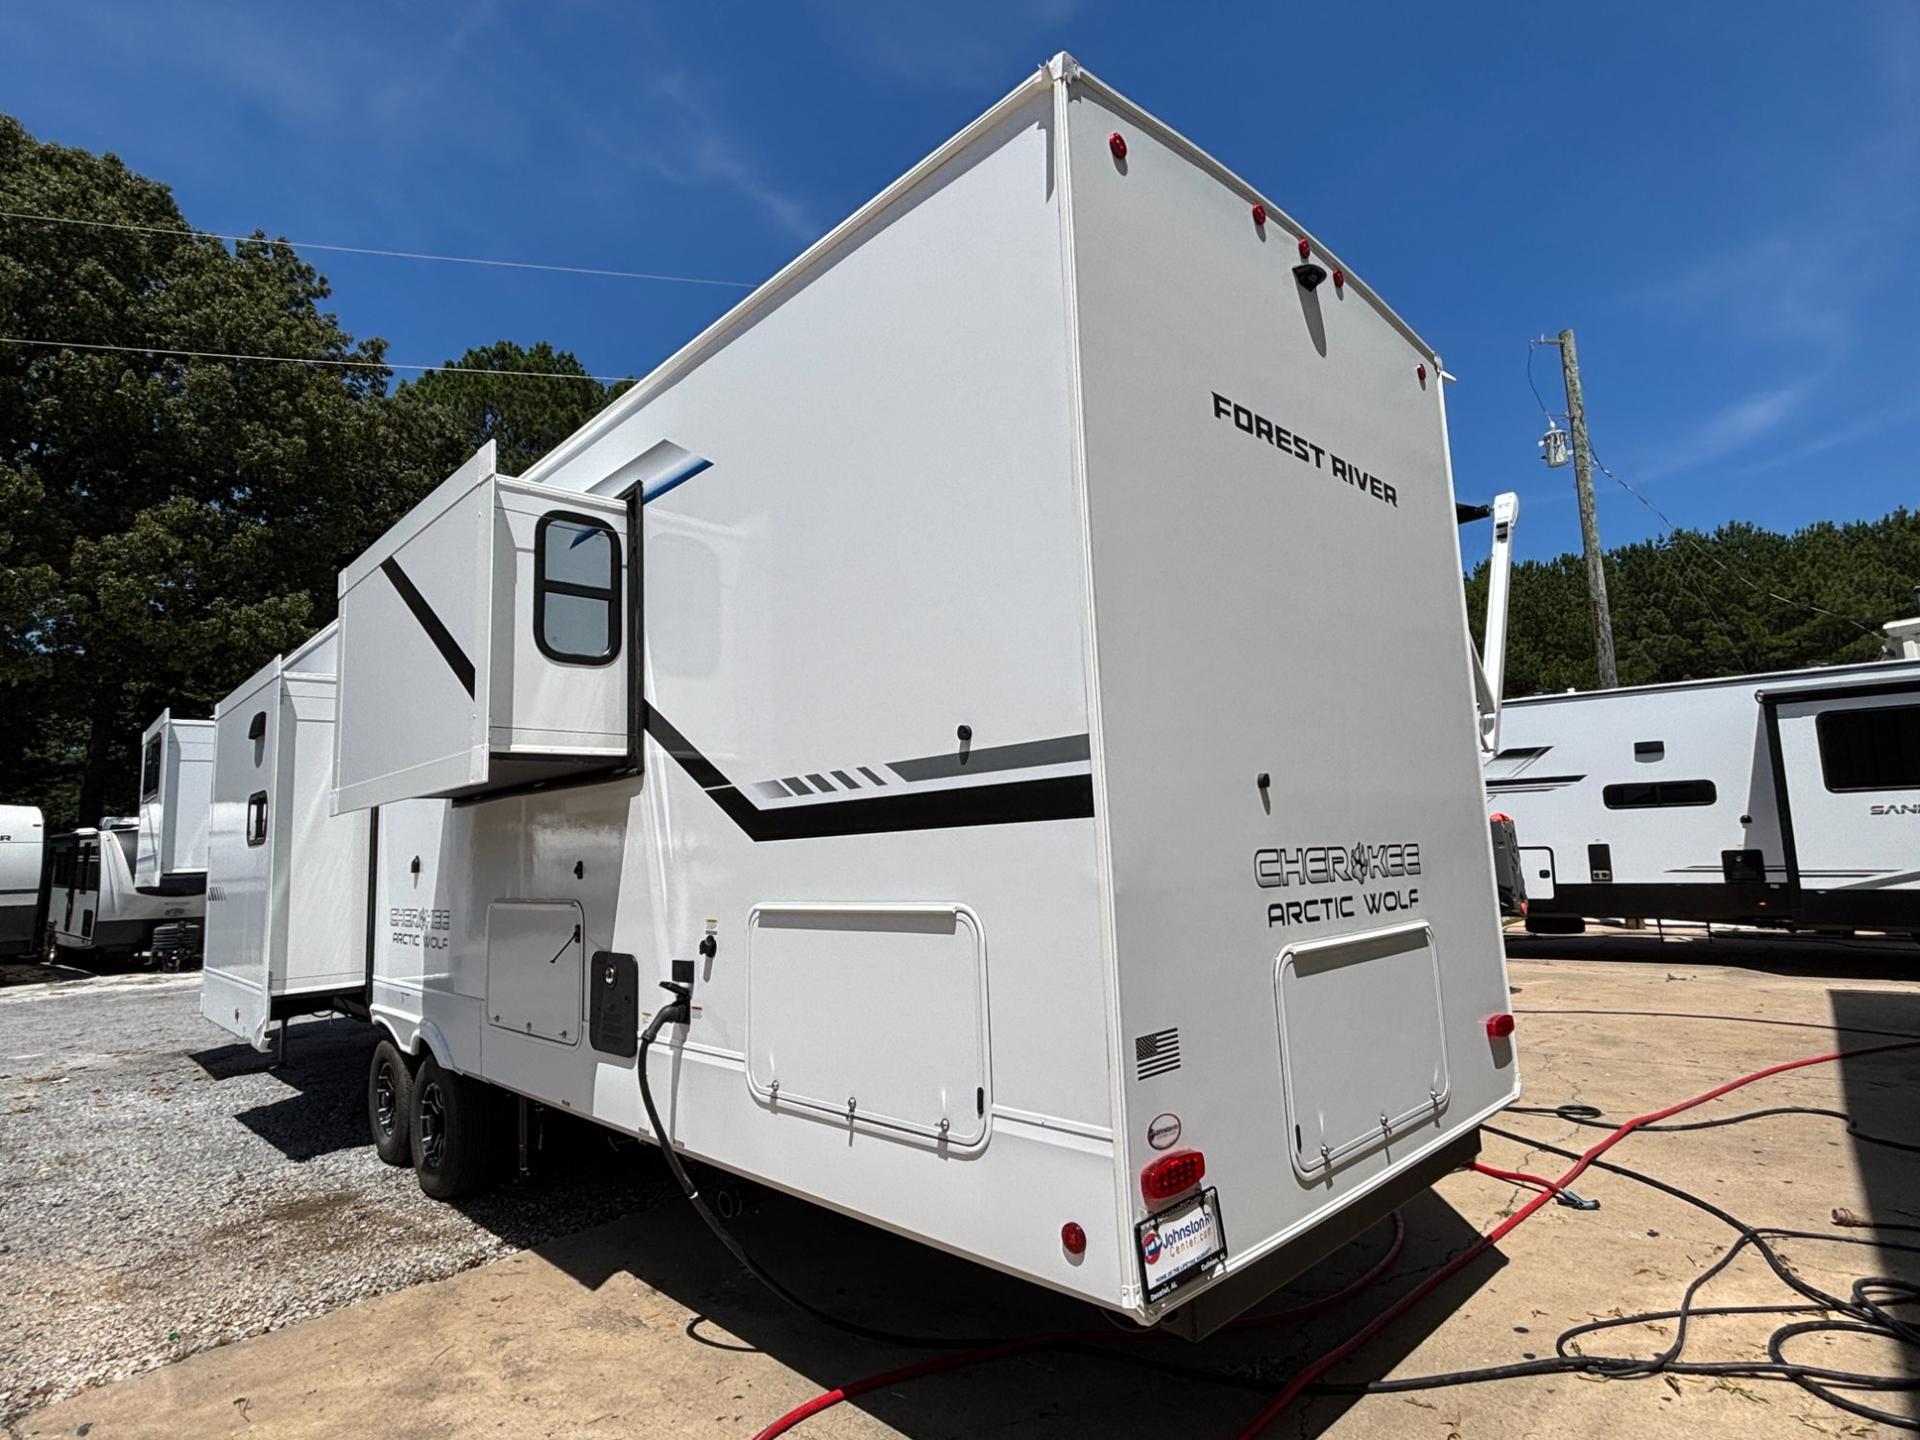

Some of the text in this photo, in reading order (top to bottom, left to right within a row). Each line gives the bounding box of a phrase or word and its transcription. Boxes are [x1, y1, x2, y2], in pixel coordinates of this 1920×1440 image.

[1211, 390, 1399, 508] FOREST RIVER
[1267, 888, 1419, 928] ARCTIC WOLF
[392, 932, 448, 950] ARCTIC WOLF
[1162, 1217, 1205, 1249] Johnston
[1169, 1226, 1212, 1258] Center.com
